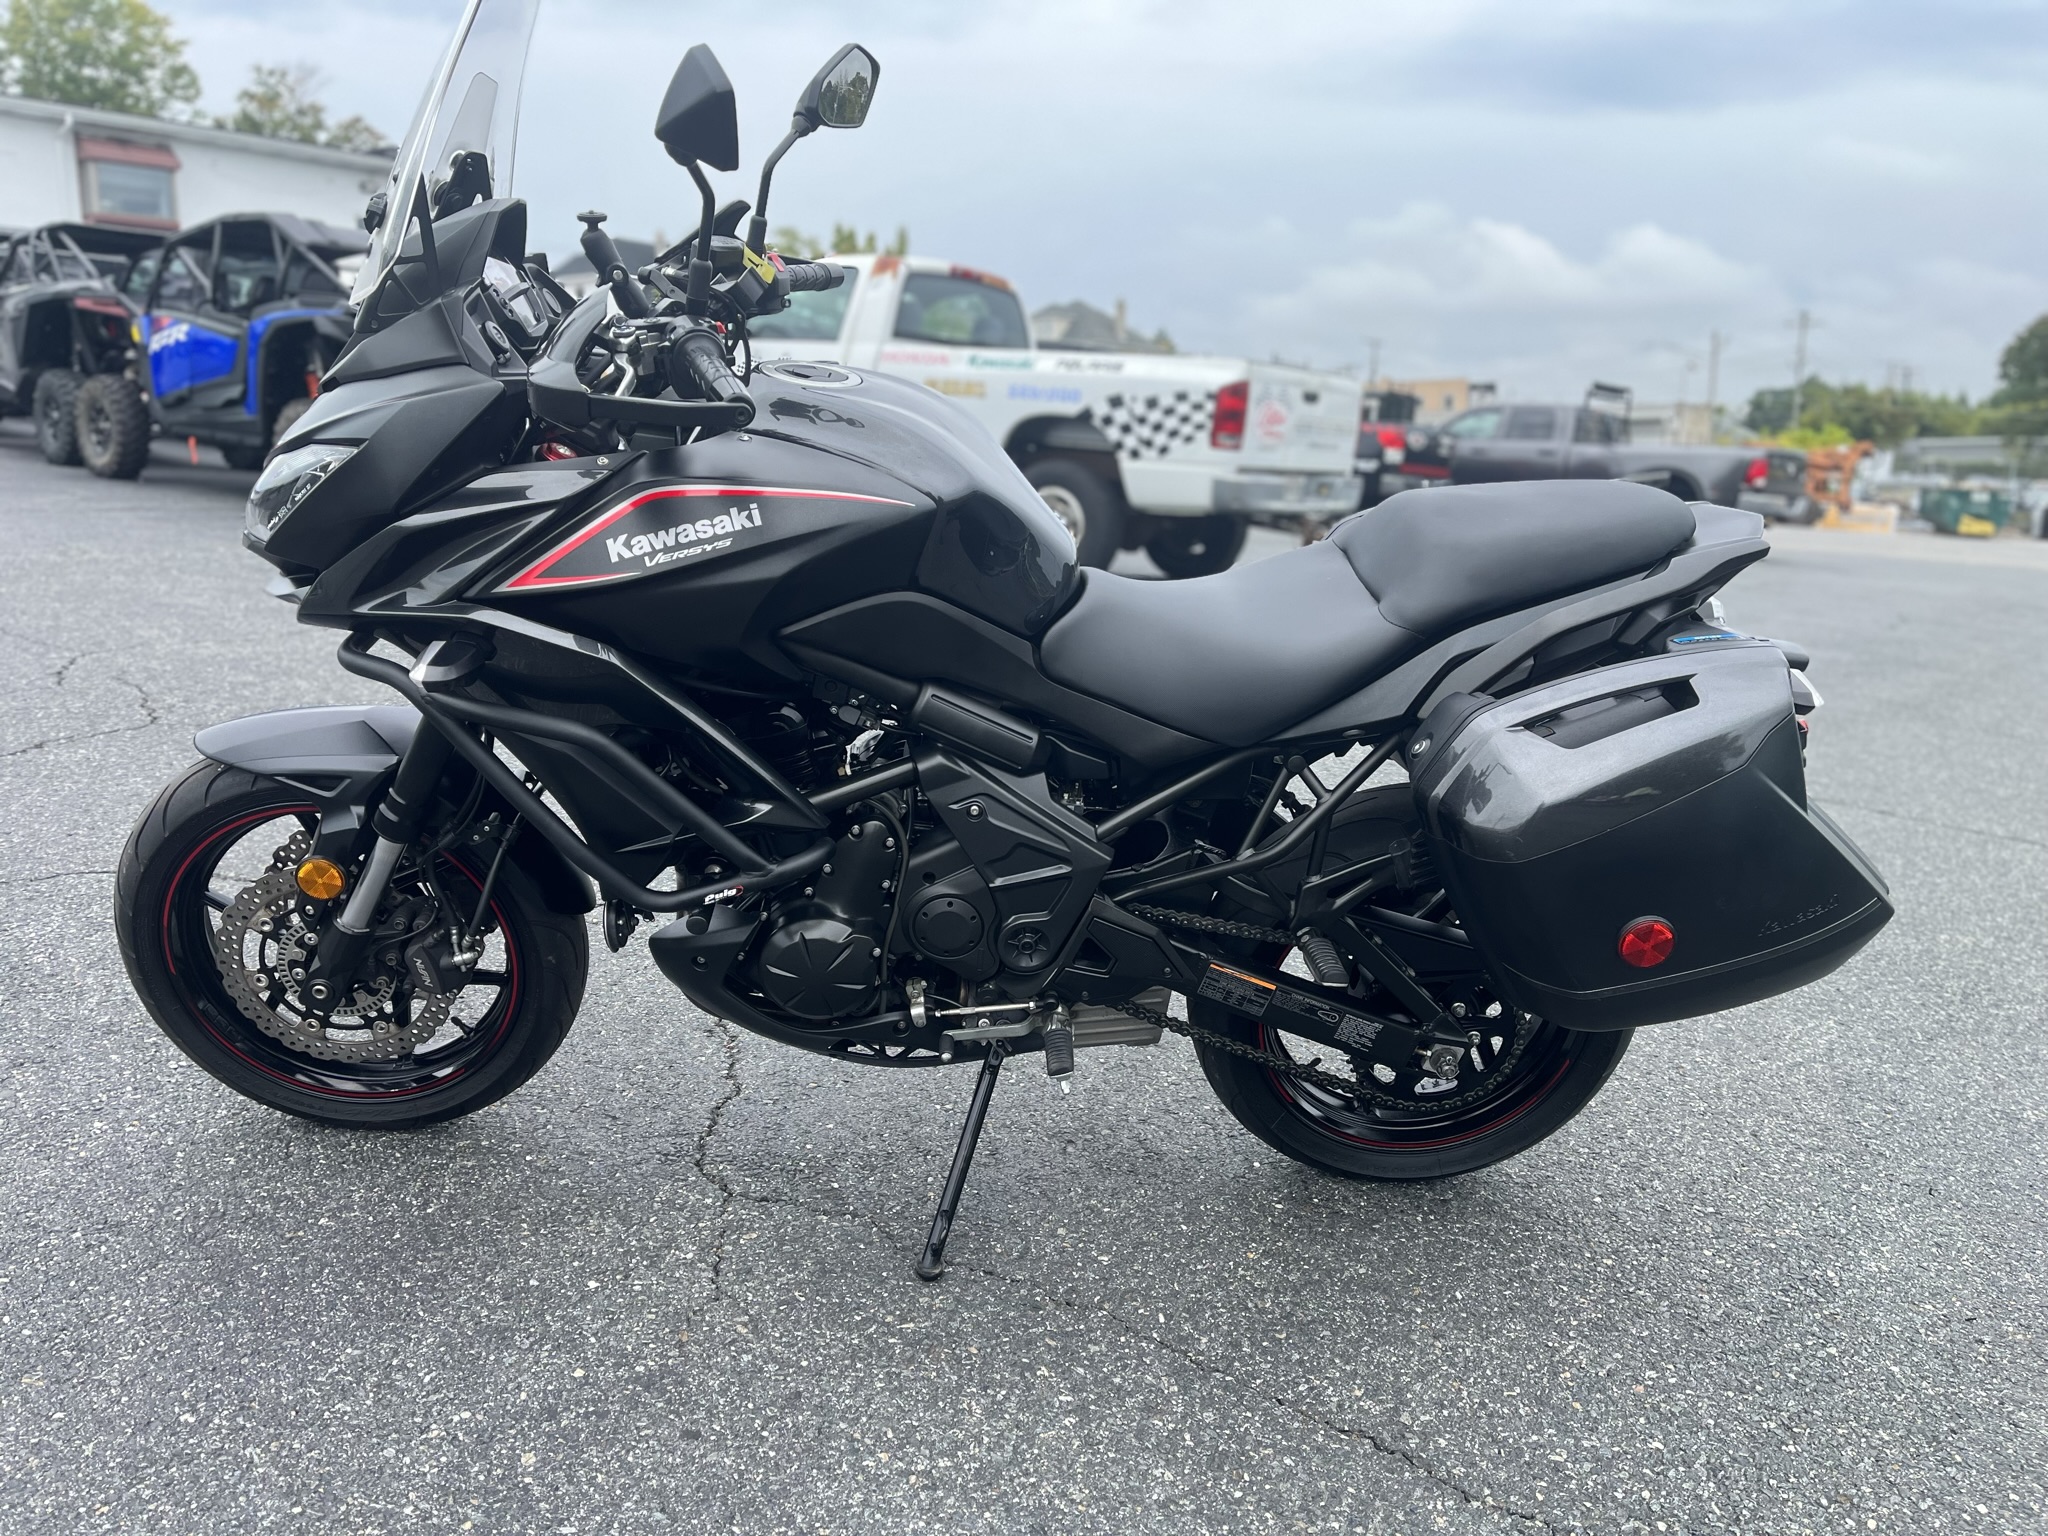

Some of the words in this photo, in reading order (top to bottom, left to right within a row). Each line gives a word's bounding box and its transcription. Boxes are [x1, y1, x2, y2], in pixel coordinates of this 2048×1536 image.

[605, 503, 763, 564] Kawasaki
[644, 537, 734, 568] VERSYS
[1757, 893, 1839, 937] Kawasaki
